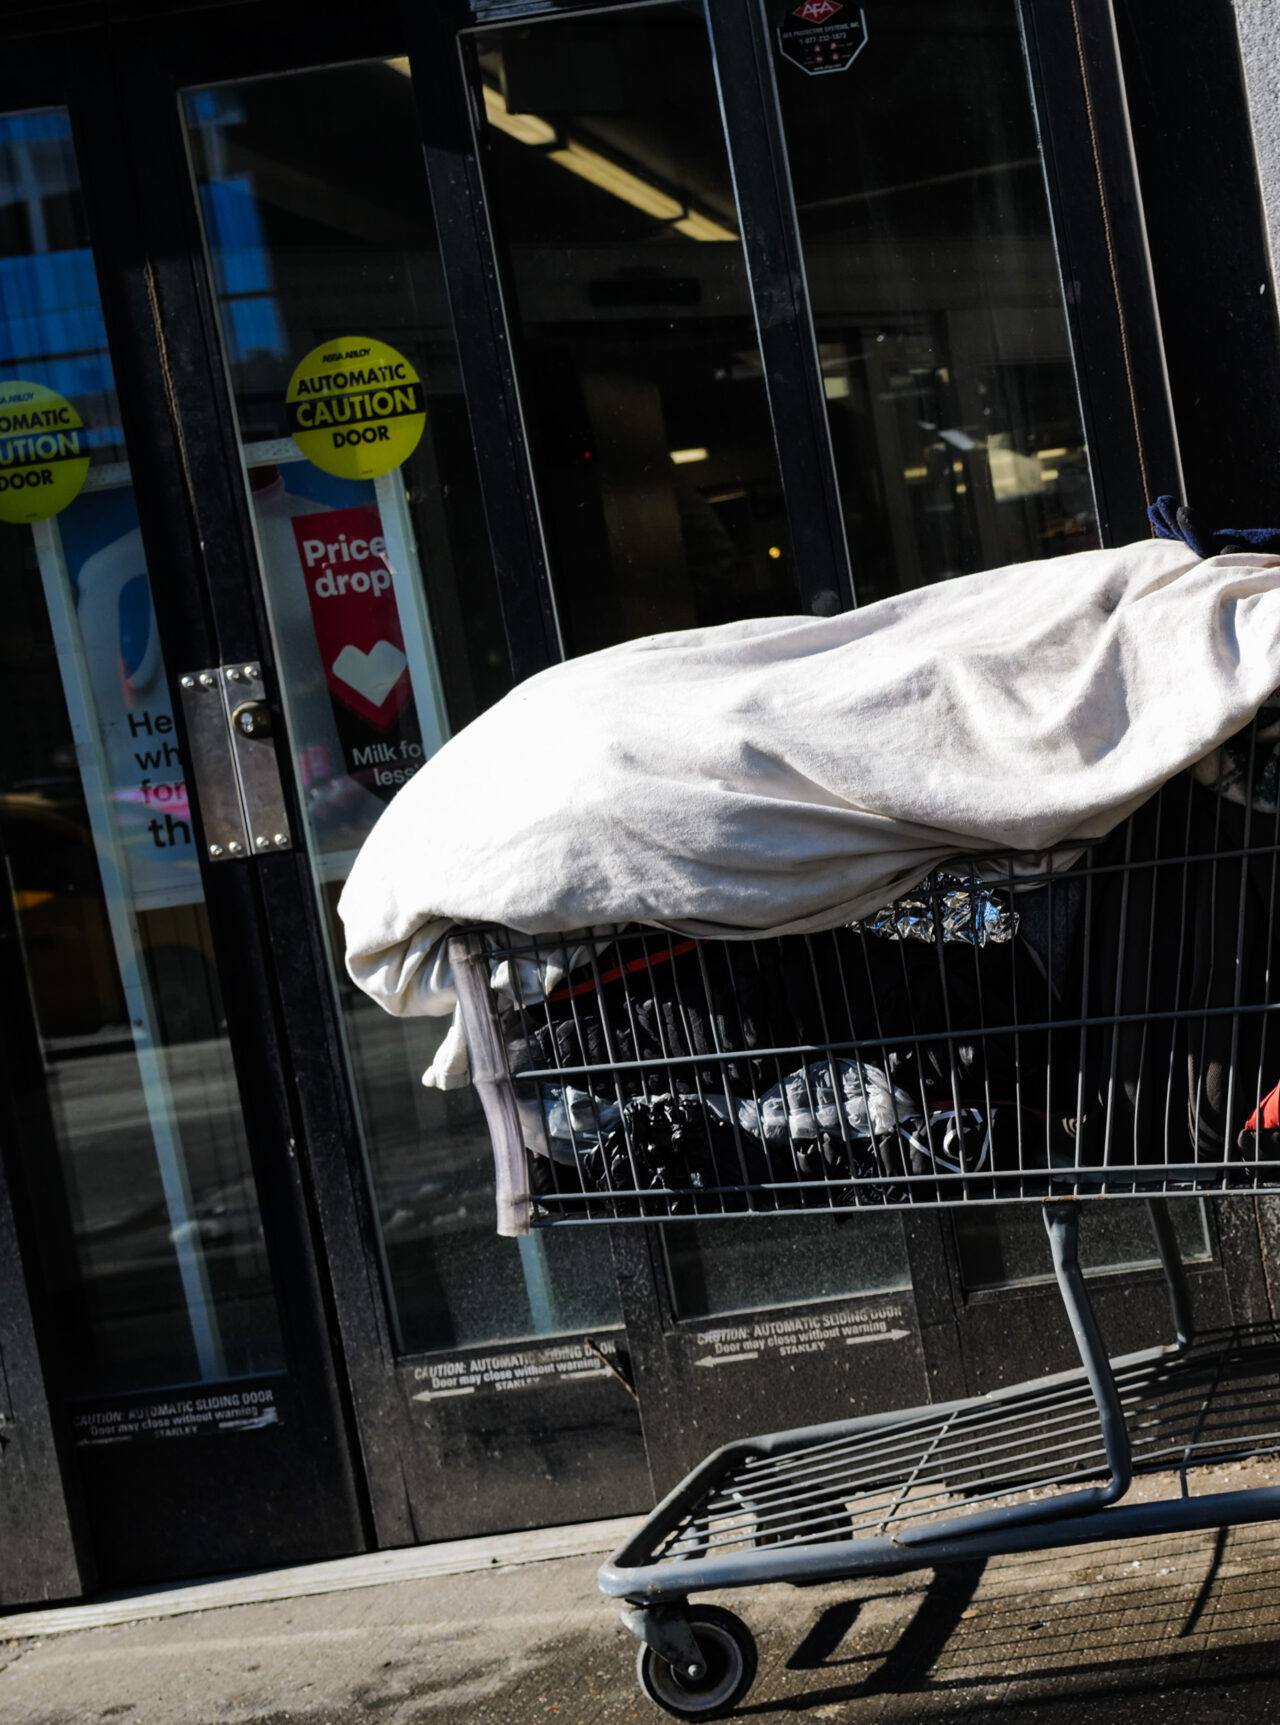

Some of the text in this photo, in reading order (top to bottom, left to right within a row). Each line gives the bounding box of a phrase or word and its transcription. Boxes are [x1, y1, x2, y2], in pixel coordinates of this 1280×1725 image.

[803, 0, 835, 17] AFA
[297, 363, 406, 396] AUTOMATIC
[296, 387, 417, 427] CAUTION
[332, 425, 390, 449] DOOR
[0, 469, 54, 492] DOOR
[303, 534, 387, 567] Price
[315, 568, 392, 598] drop
[352, 742, 397, 767] Milk
[714, 1321, 887, 1354] Door may close without warning
[754, 1318, 821, 1338] AUTOMATIC
[823, 1310, 868, 1327] SLIDING
[779, 1341, 826, 1356] STANLEY
[415, 1361, 466, 1380] CAUTION:
[432, 1355, 601, 1389] Door may close without warning
[118, 1420, 139, 1434] may
[142, 1415, 170, 1429] close
[172, 1409, 213, 1425] without
[214, 1403, 259, 1421] warning
[128, 1400, 193, 1419] AUTOMATIC
[195, 1394, 240, 1411] SLIDING
[242, 1389, 274, 1405] DOOR
